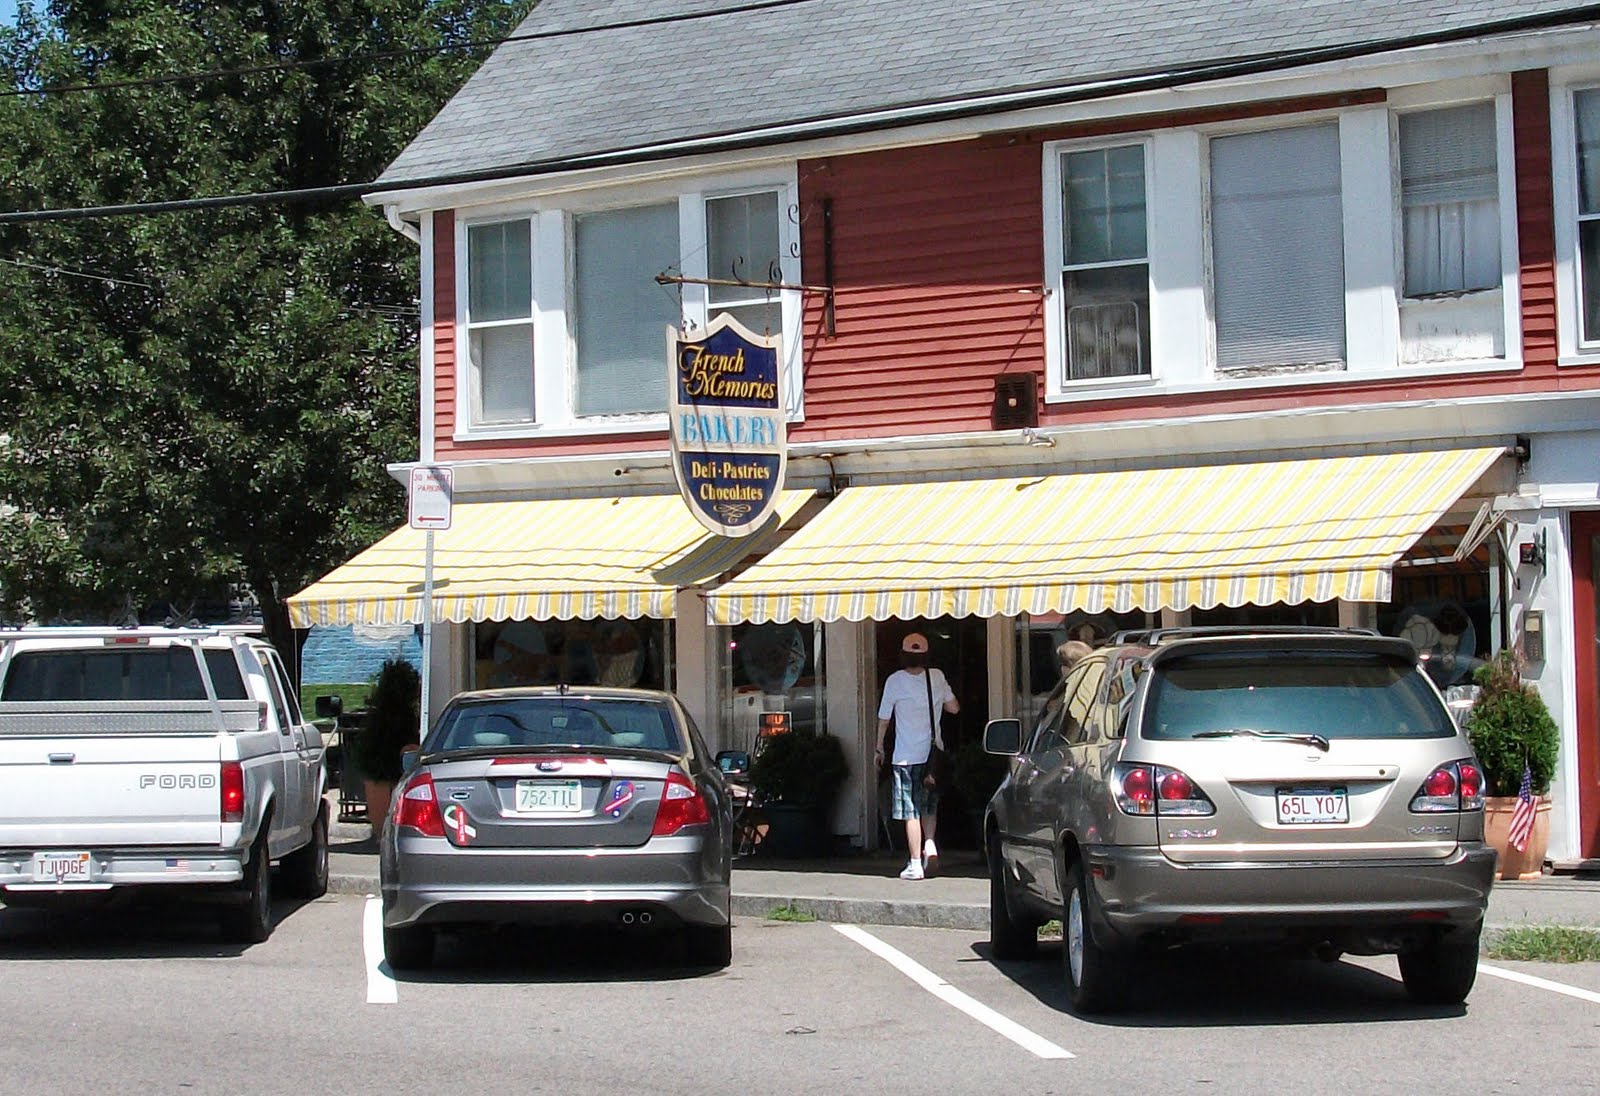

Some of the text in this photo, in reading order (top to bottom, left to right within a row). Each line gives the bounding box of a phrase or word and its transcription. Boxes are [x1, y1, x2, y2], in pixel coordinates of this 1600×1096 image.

[679, 345, 744, 382] French
[686, 371, 775, 398] Memories
[680, 414, 777, 444] BAKERY
[692, 461, 769, 479] Deli Pastries
[700, 483, 763, 500] Chocolates
[140, 774, 215, 789] FORD
[1282, 796, 1343, 814] 65L Y07
